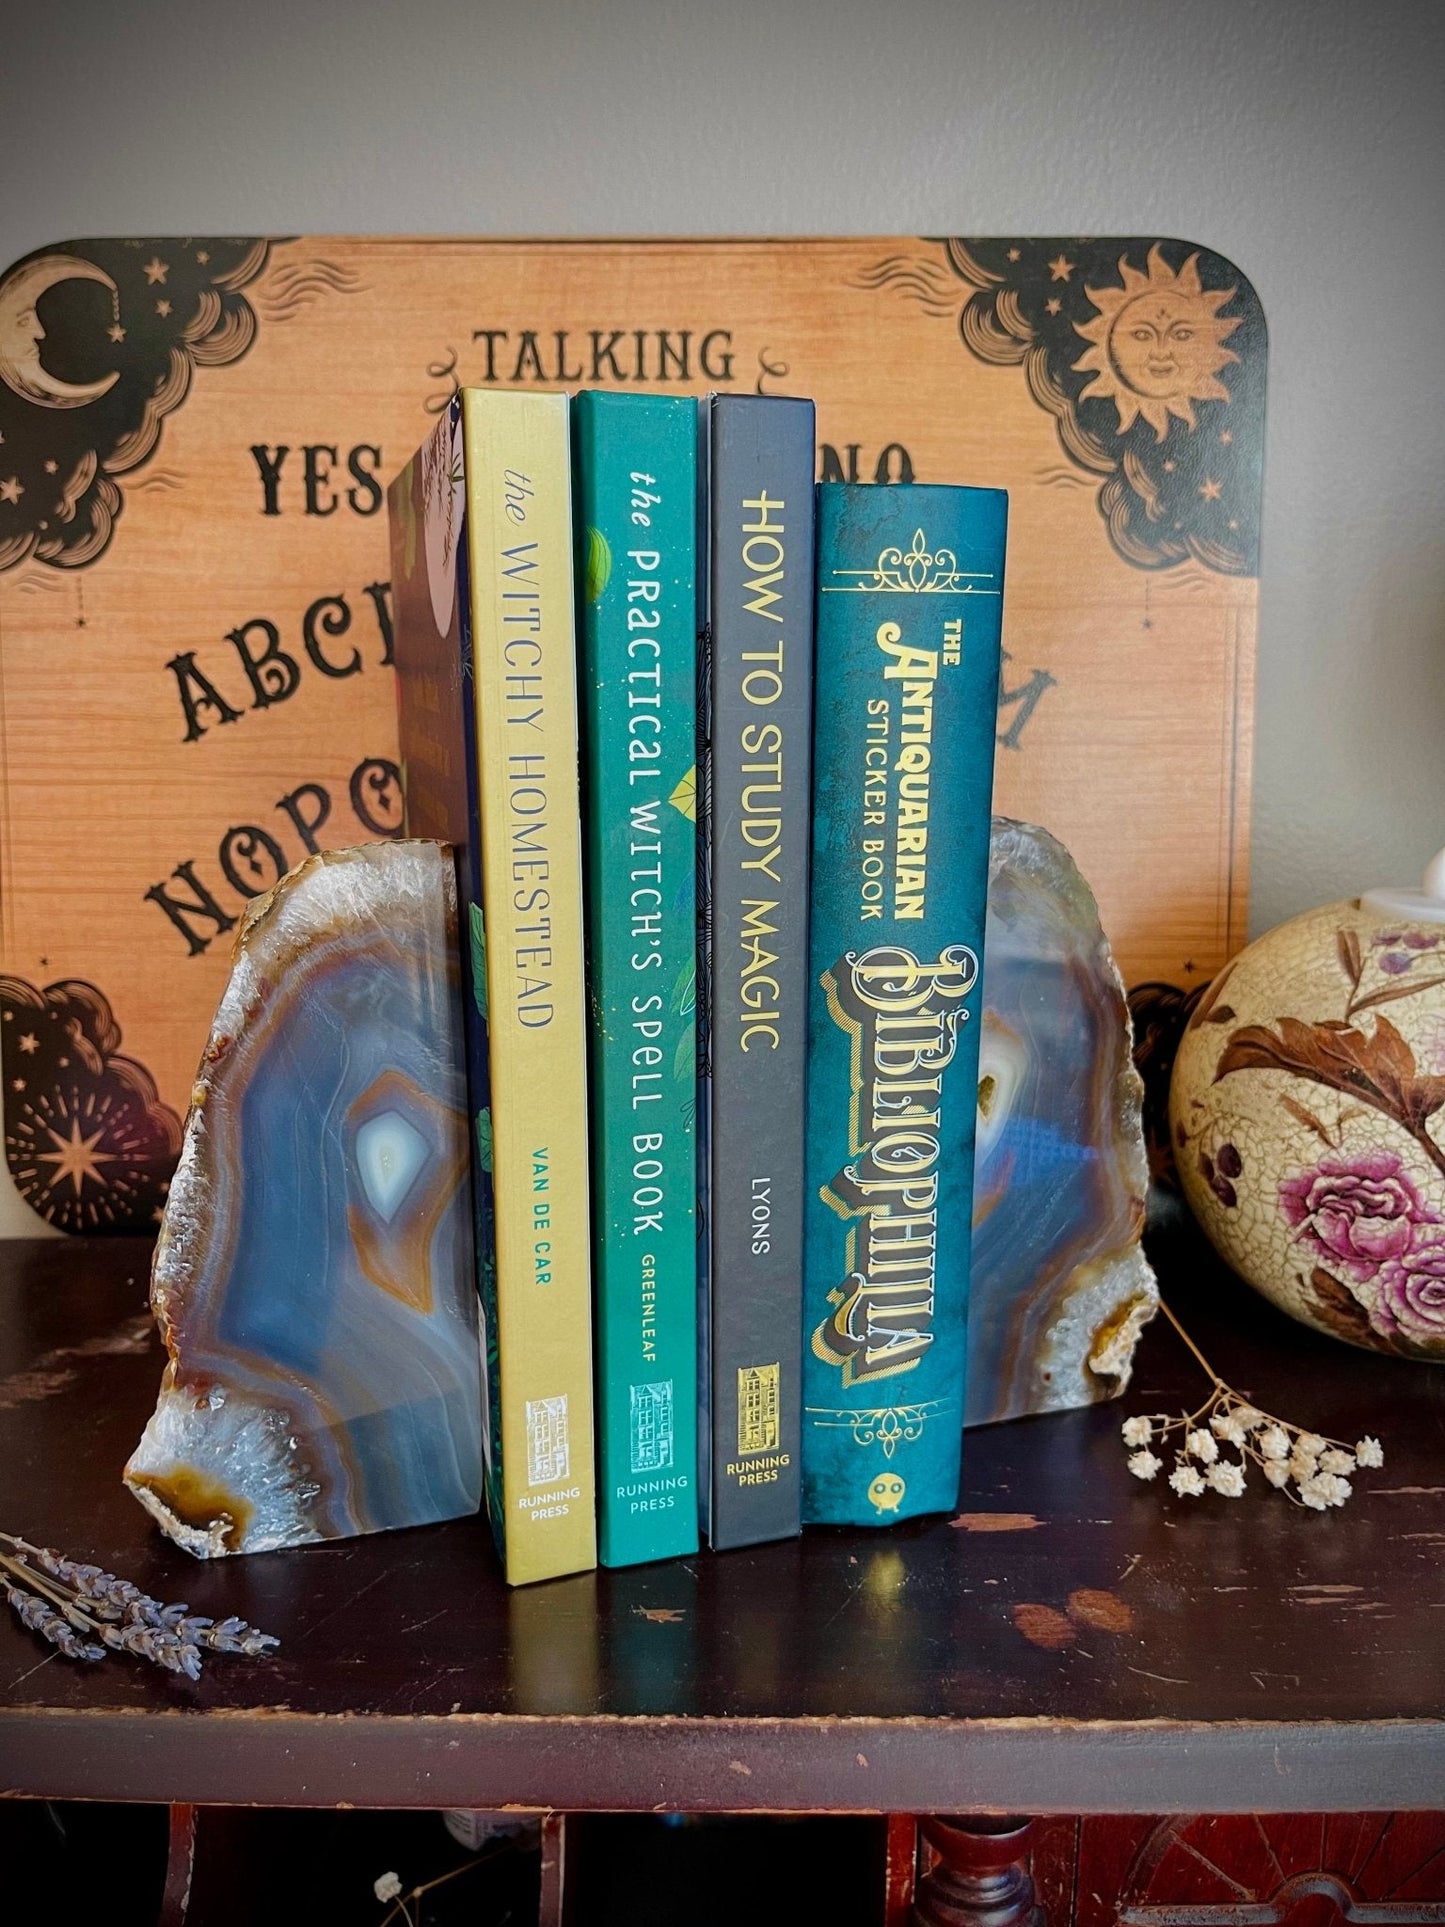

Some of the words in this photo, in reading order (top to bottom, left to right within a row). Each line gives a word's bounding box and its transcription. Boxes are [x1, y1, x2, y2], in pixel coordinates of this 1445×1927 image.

[473, 329, 736, 381] TALKING
[250, 444, 384, 517] YES
[818, 442, 915, 484] NO
[503, 469, 534, 527] the
[629, 471, 661, 527] the
[741, 489, 785, 623] HOW
[500, 542, 544, 732] WITCHY
[942, 618, 963, 666] THE
[741, 640, 783, 706] TO
[863, 699, 889, 826] STICKER
[876, 621, 938, 919] ANTIQUARIAN
[740, 722, 782, 883] STUDY
[508, 755, 554, 1028] HOMESTEAD
[630, 800, 663, 971] WITCH'S
[860, 838, 885, 921] BOOK
[740, 899, 781, 1053] MAGIC
[532, 1146, 550, 1192] VAN
[632, 1133, 664, 1236] BOOK
[834, 944, 979, 1365] BIBLIOPHILIA
[533, 1203, 550, 1231] DE
[749, 1176, 772, 1256] LYONS
[534, 1241, 551, 1286] CAR
[641, 1254, 656, 1362] GREENLEAF
[518, 1486, 581, 1509] RUNNING
[616, 1475, 688, 1498] RUNNING
[725, 1454, 790, 1475] RUNNING
[738, 1469, 778, 1486] PRESS
[531, 1504, 569, 1521] PRESS
[630, 1495, 675, 1514] PRESS
